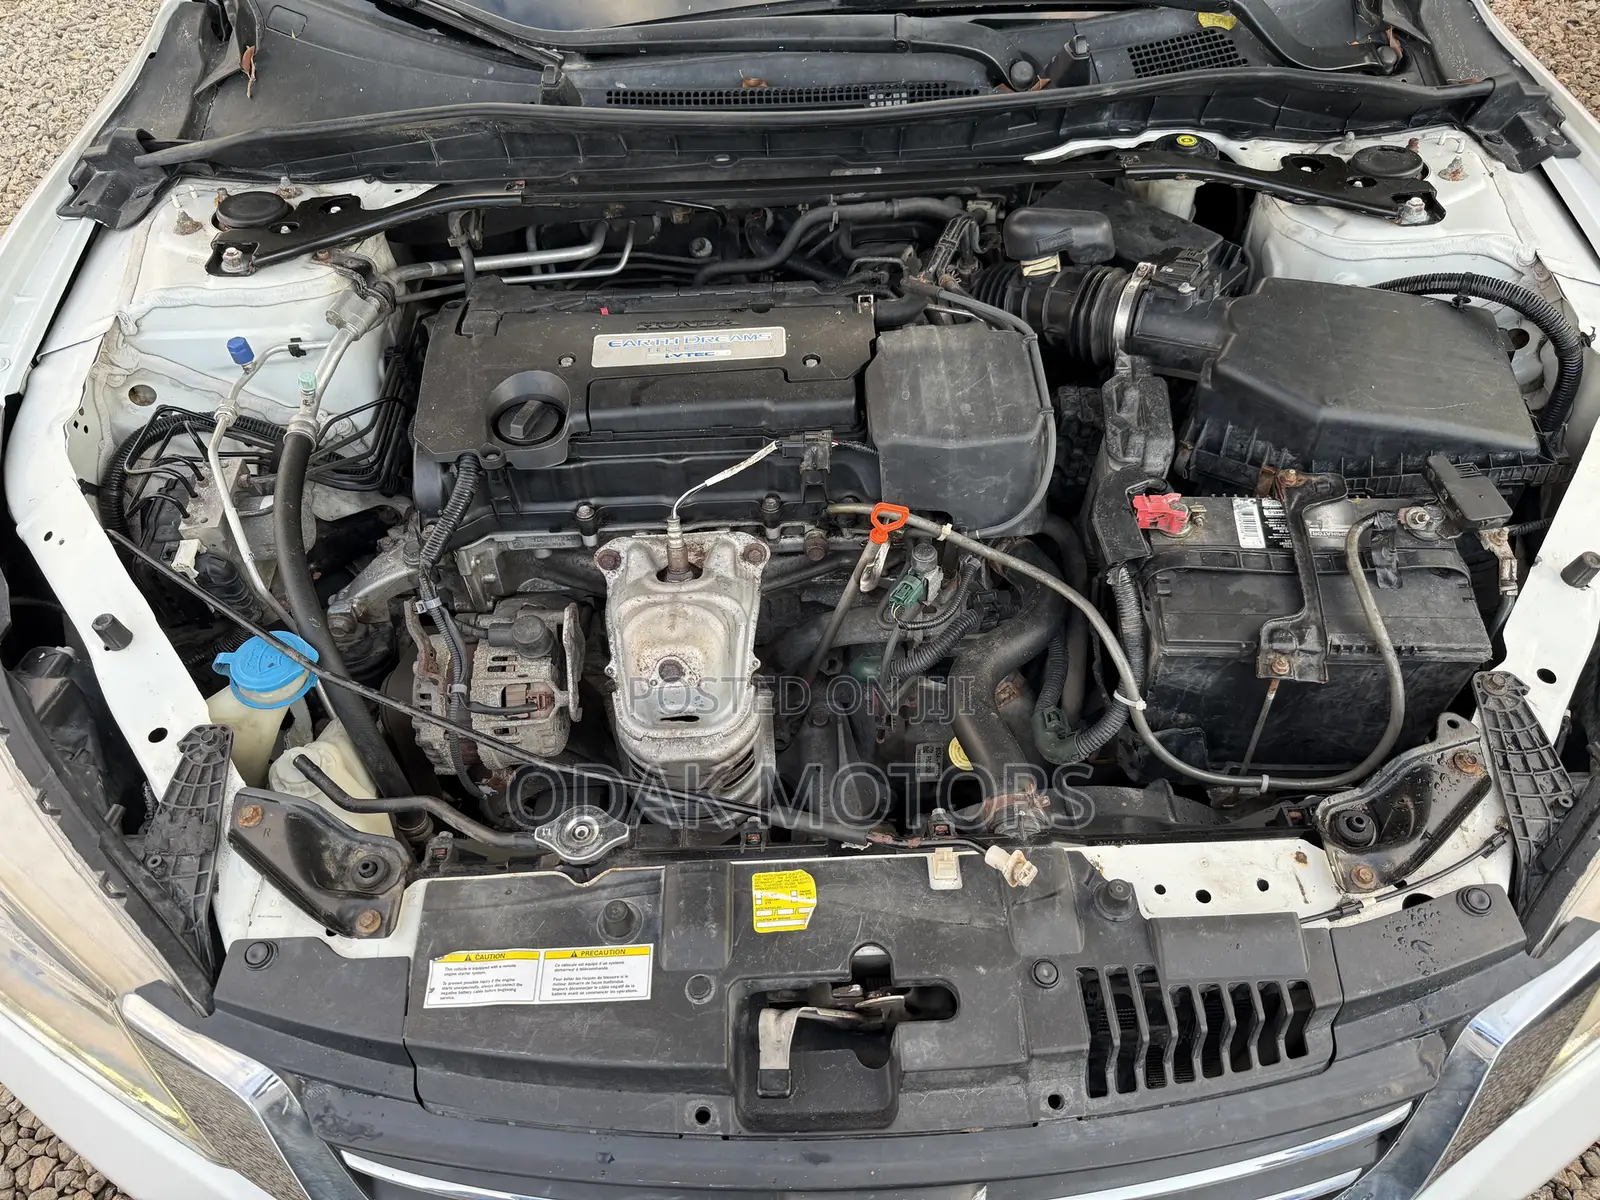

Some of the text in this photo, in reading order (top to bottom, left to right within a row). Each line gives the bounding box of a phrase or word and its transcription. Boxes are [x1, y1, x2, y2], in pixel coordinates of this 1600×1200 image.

[636, 319, 742, 331] HONDA
[608, 331, 772, 348] EARTH DREAMS
[262, 827, 272, 838] R
[475, 953, 505, 961] CAUTION
[580, 949, 626, 957] PRECAUTION
